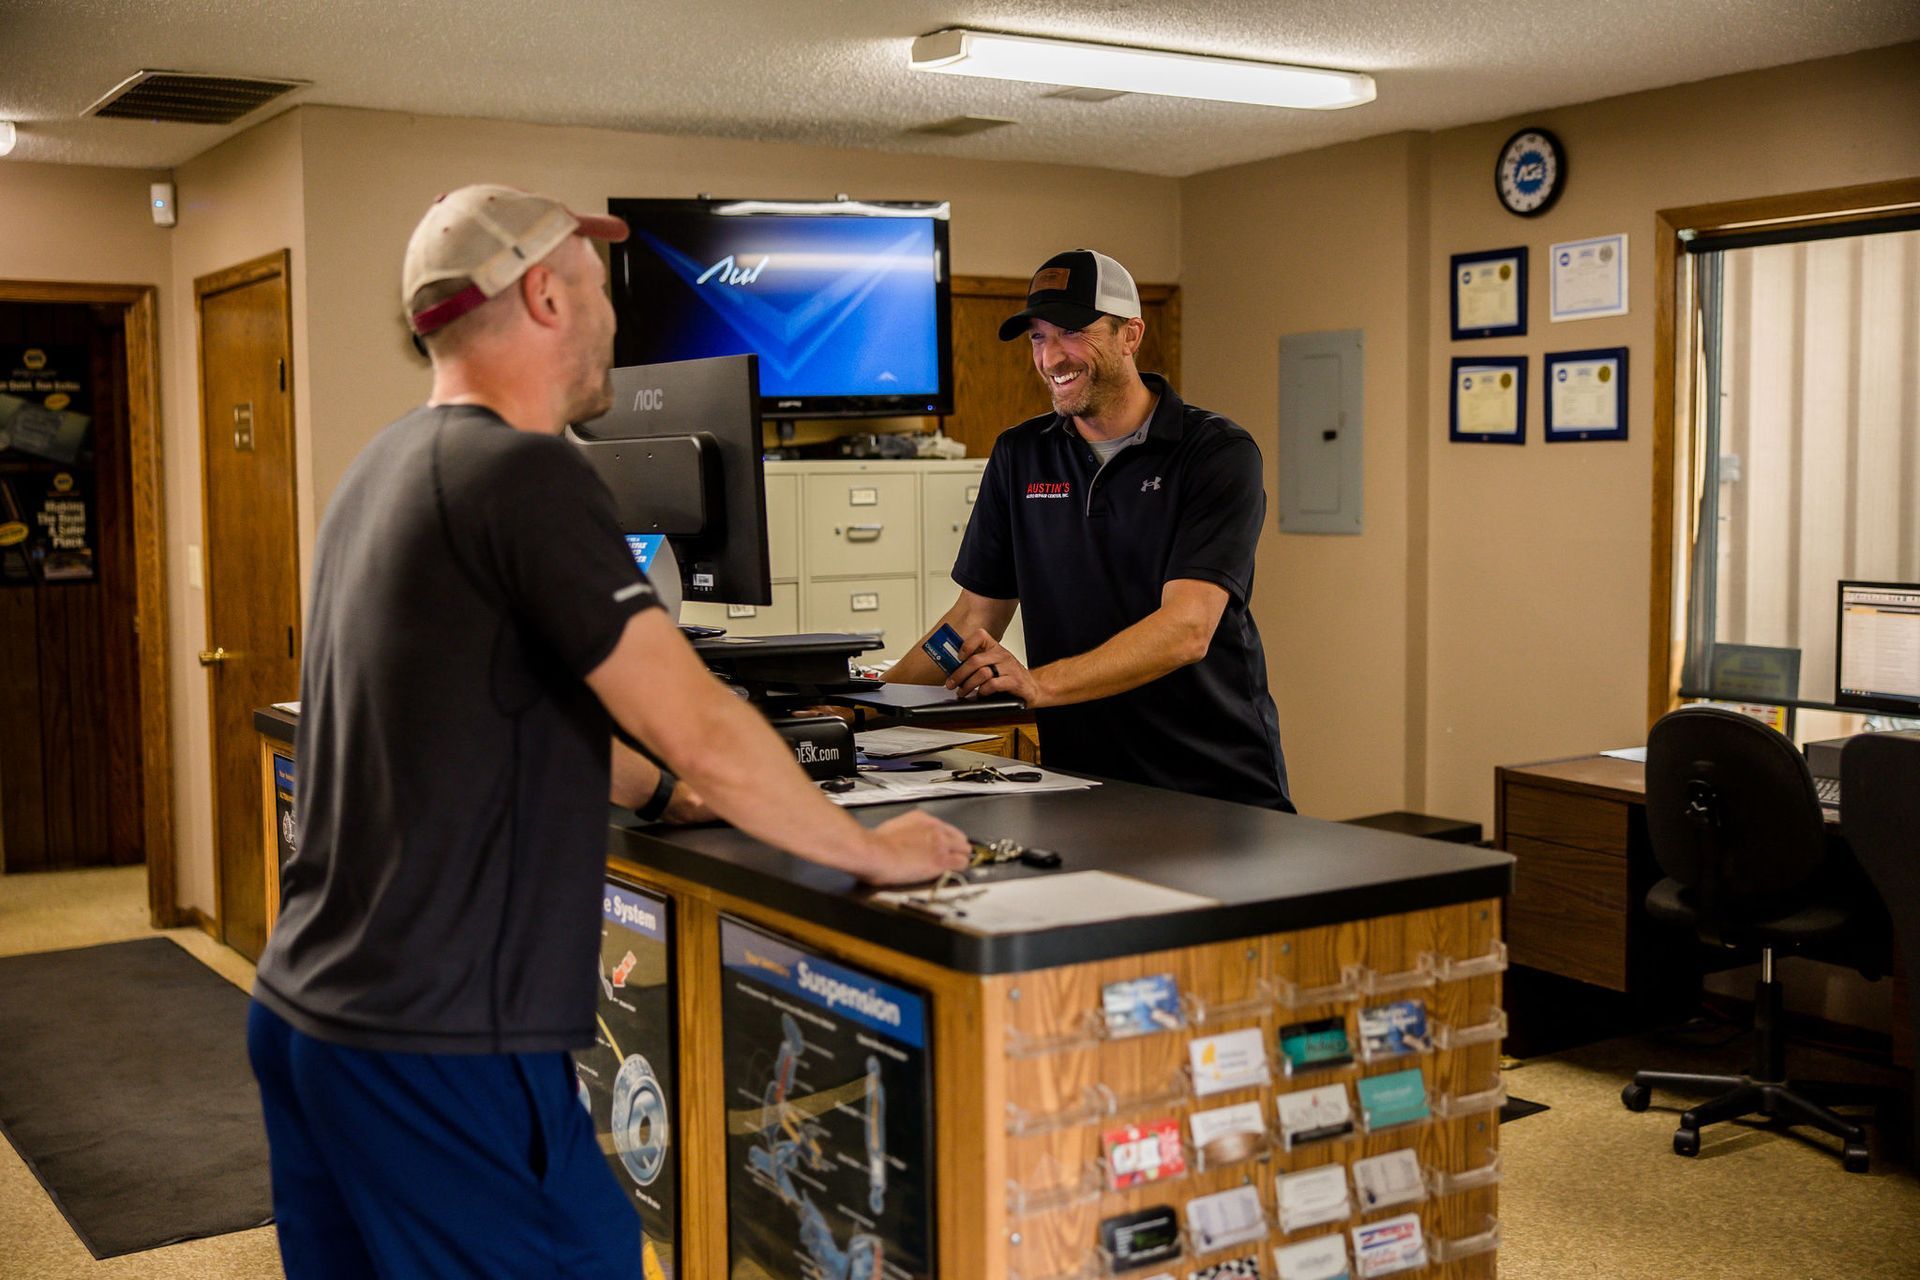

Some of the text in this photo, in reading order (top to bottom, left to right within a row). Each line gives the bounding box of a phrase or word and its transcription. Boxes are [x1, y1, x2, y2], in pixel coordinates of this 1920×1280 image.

[633, 388, 664, 412] AOC
[1026, 482, 1070, 494] AUSTIN'S
[613, 894, 657, 932] System
[797, 960, 901, 1027] Suspension
